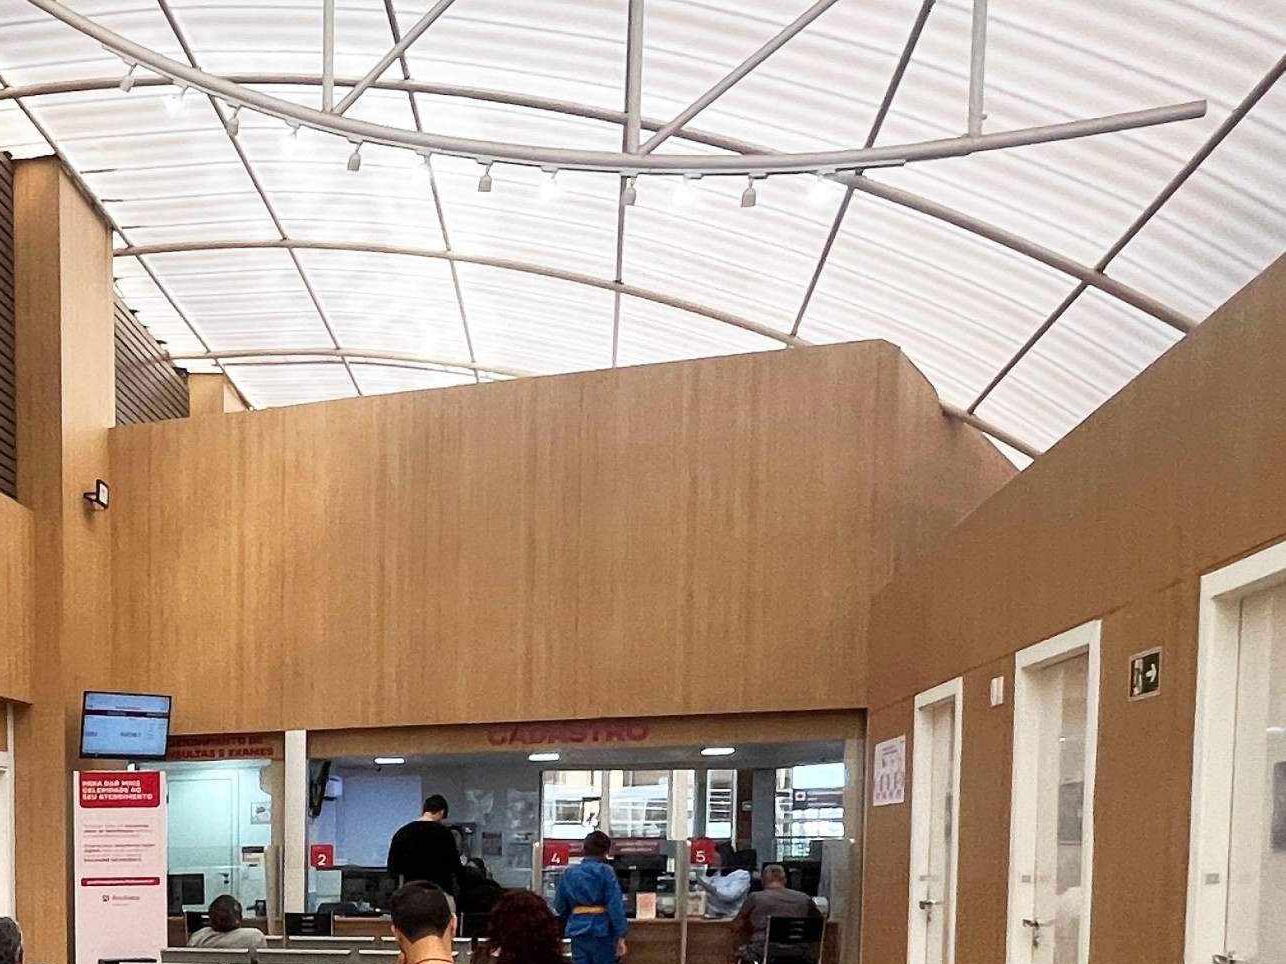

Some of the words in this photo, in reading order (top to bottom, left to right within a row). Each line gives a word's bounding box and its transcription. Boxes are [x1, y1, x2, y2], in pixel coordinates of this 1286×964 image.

[317, 853, 326, 865] 2
[551, 853, 561, 864] 4
[695, 849, 706, 862] 5
